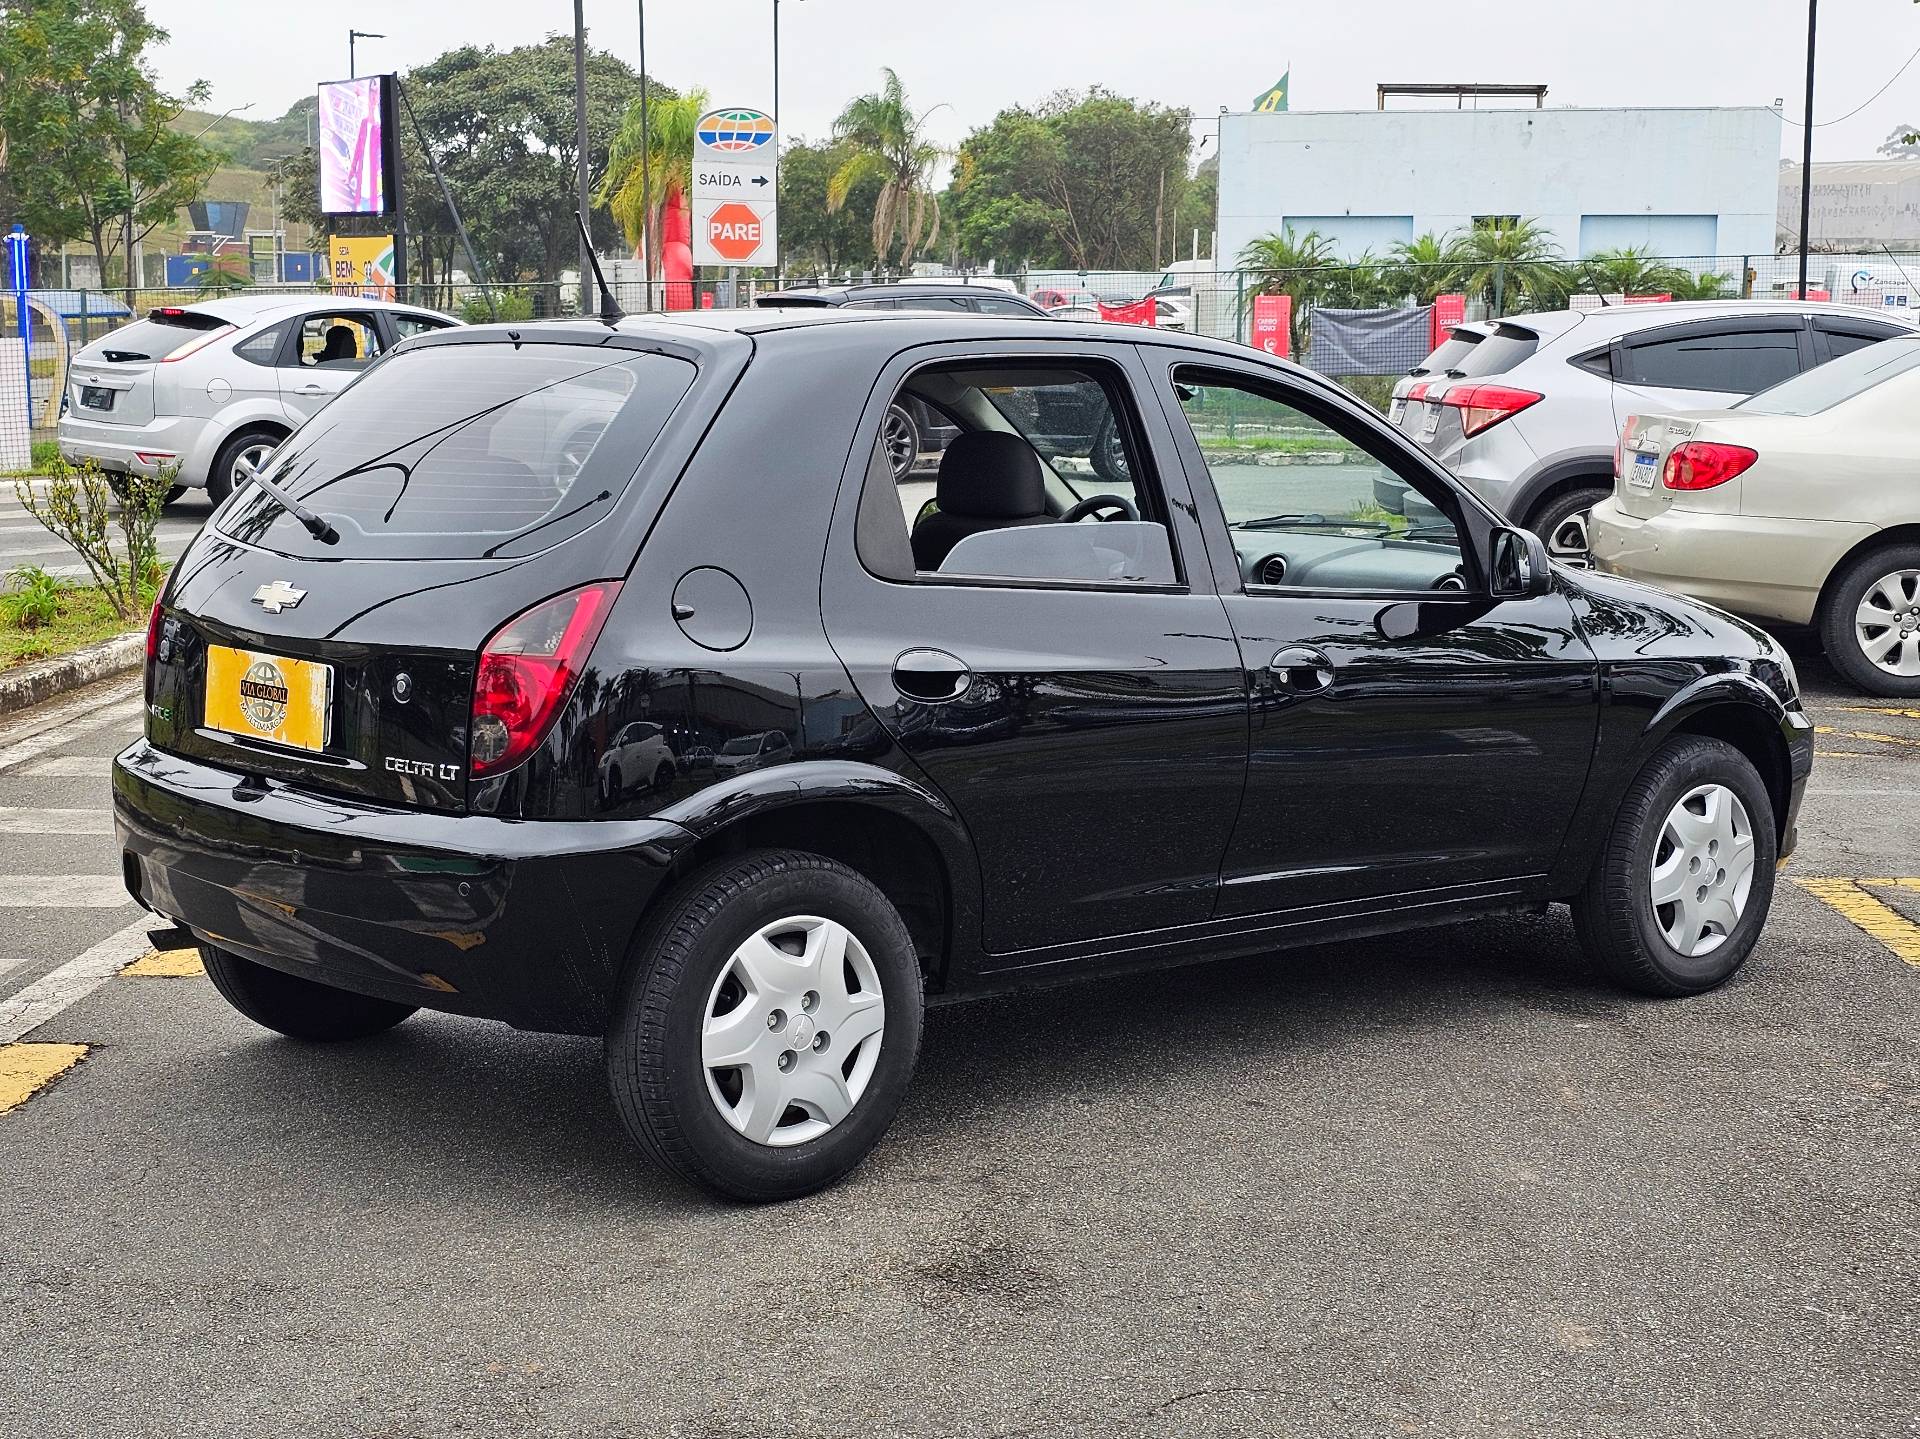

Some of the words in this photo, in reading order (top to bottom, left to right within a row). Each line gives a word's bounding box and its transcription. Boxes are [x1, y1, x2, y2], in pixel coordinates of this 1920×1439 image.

[699, 171, 742, 187] SAÍDA
[710, 223, 760, 241] PARE
[335, 260, 356, 278] BEM-
[241, 681, 255, 697] VIA
[256, 685, 288, 703] GLOBAL
[240, 701, 287, 732] MULTIMARCAS
[384, 756, 435, 777] CELTA
[440, 764, 460, 780] LT
